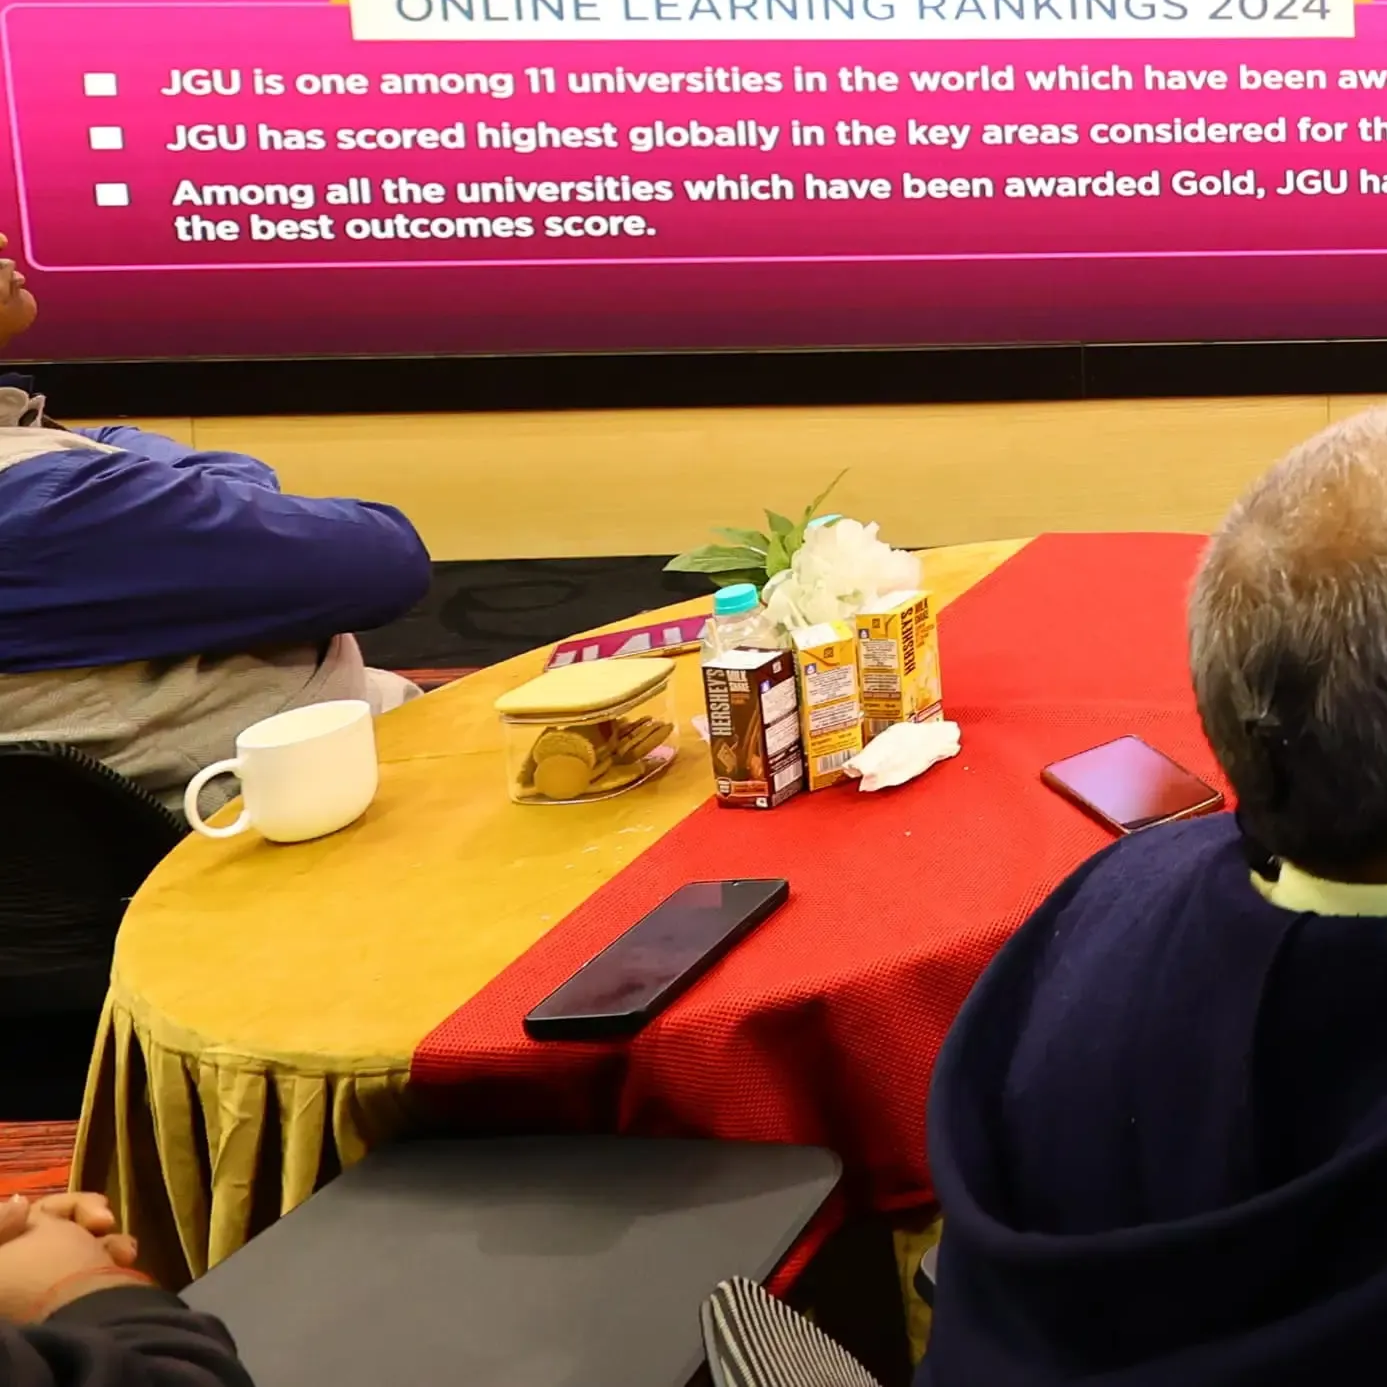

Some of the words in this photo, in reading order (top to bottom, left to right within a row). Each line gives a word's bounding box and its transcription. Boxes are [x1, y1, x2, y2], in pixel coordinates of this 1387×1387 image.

[161, 69, 240, 95] JGU
[254, 69, 284, 94] is
[296, 74, 368, 94] one
[381, 73, 514, 98] among
[525, 68, 555, 93] 11
[568, 67, 783, 93] universities
[795, 66, 827, 91] in
[839, 66, 899, 91] the
[910, 66, 1014, 91] world
[1026, 65, 1132, 90] which
[1145, 65, 1227, 89] have
[1240, 65, 1326, 89] been
[167, 125, 246, 150] JGU
[259, 124, 326, 150] has
[337, 122, 465, 149] scored
[478, 122, 617, 152] highest
[629, 120, 779, 151] globally
[792, 120, 824, 146] in
[836, 120, 896, 145] the
[909, 120, 970, 149] key
[982, 124, 1079, 144] areas
[1090, 117, 1286, 143] considered
[1297, 117, 1348, 142] for
[173, 180, 314, 209] Among
[326, 178, 371, 204] all
[382, 178, 445, 203] the
[457, 176, 673, 203] universities
[684, 174, 793, 200] which
[806, 174, 891, 199] have
[903, 173, 993, 198] been
[1005, 171, 1160, 197] awarded
[1172, 170, 1265, 198] Gold,
[1277, 170, 1347, 194] JGU
[175, 215, 239, 241] the
[251, 214, 334, 240] best
[346, 214, 534, 239] outcomes
[545, 216, 655, 236] score.
[706, 668, 732, 736] HERSHEY'S
